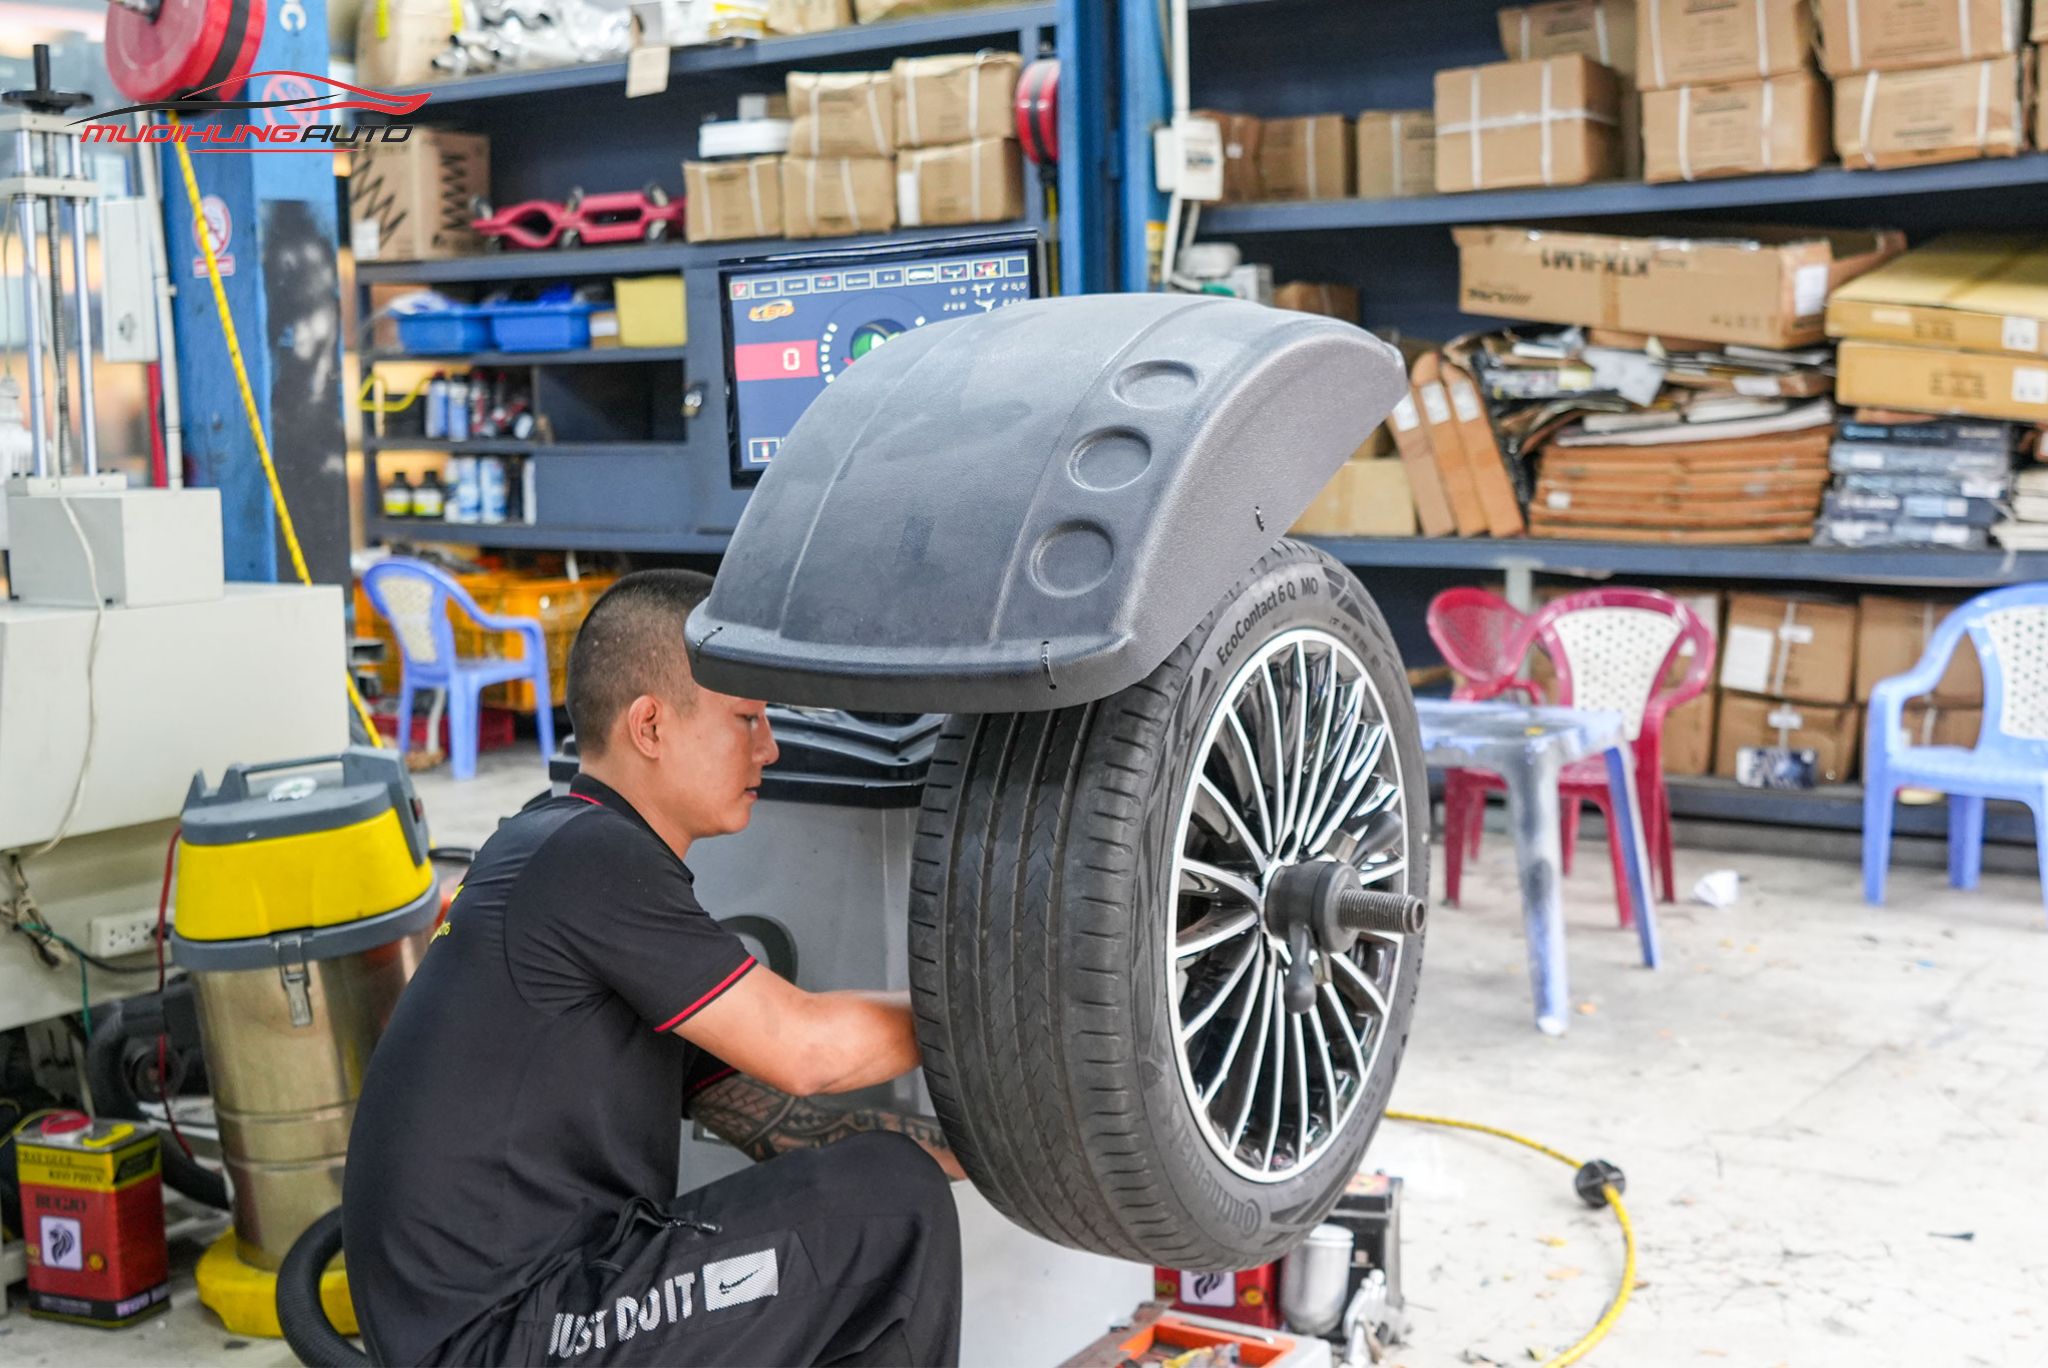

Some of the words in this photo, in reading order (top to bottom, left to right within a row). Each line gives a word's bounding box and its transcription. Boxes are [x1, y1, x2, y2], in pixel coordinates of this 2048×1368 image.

[783, 347, 800, 371] 0
[1216, 591, 1278, 667] EcoContact
[1300, 577, 1319, 596] MO
[616, 1285, 661, 1342] DO
[664, 1271, 696, 1324] IT
